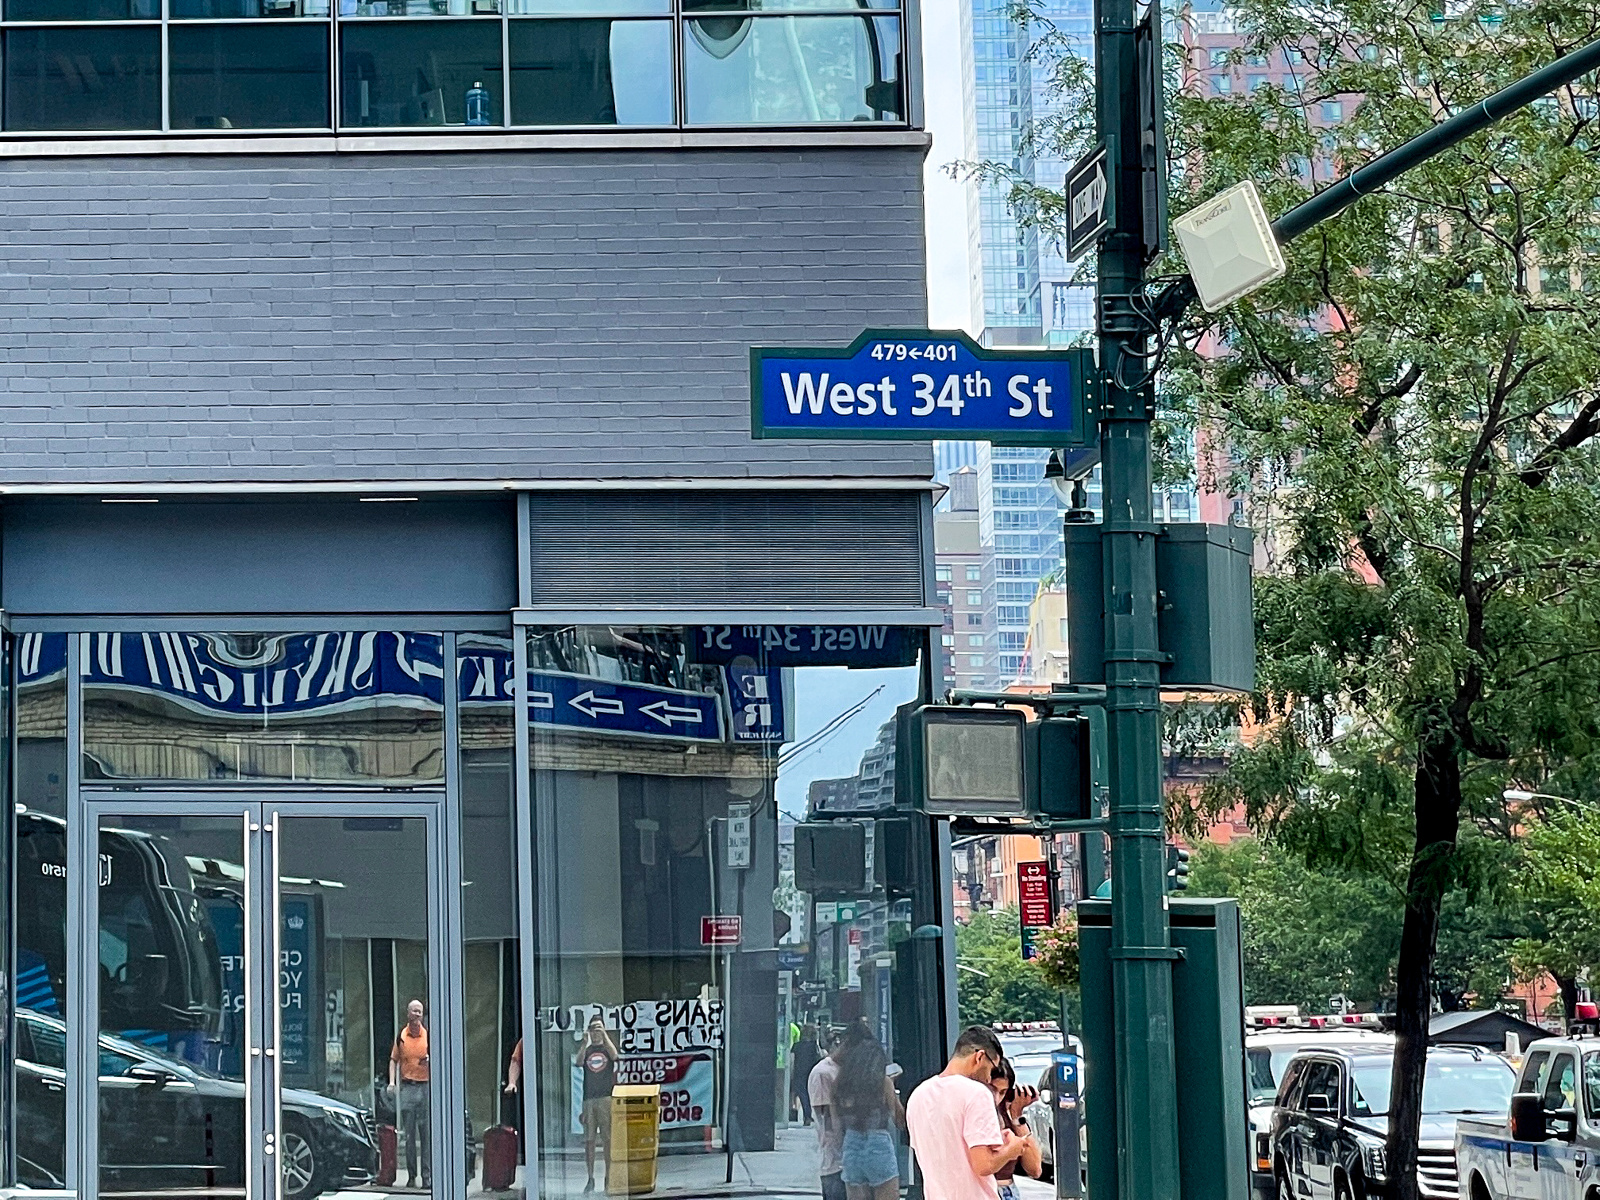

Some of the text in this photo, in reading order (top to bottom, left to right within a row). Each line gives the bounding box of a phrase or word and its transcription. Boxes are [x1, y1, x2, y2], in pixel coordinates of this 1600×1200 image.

[870, 344, 957, 362] 479 401
[780, 371, 1053, 418] West 34th St
[1063, 1065, 1074, 1081] P
